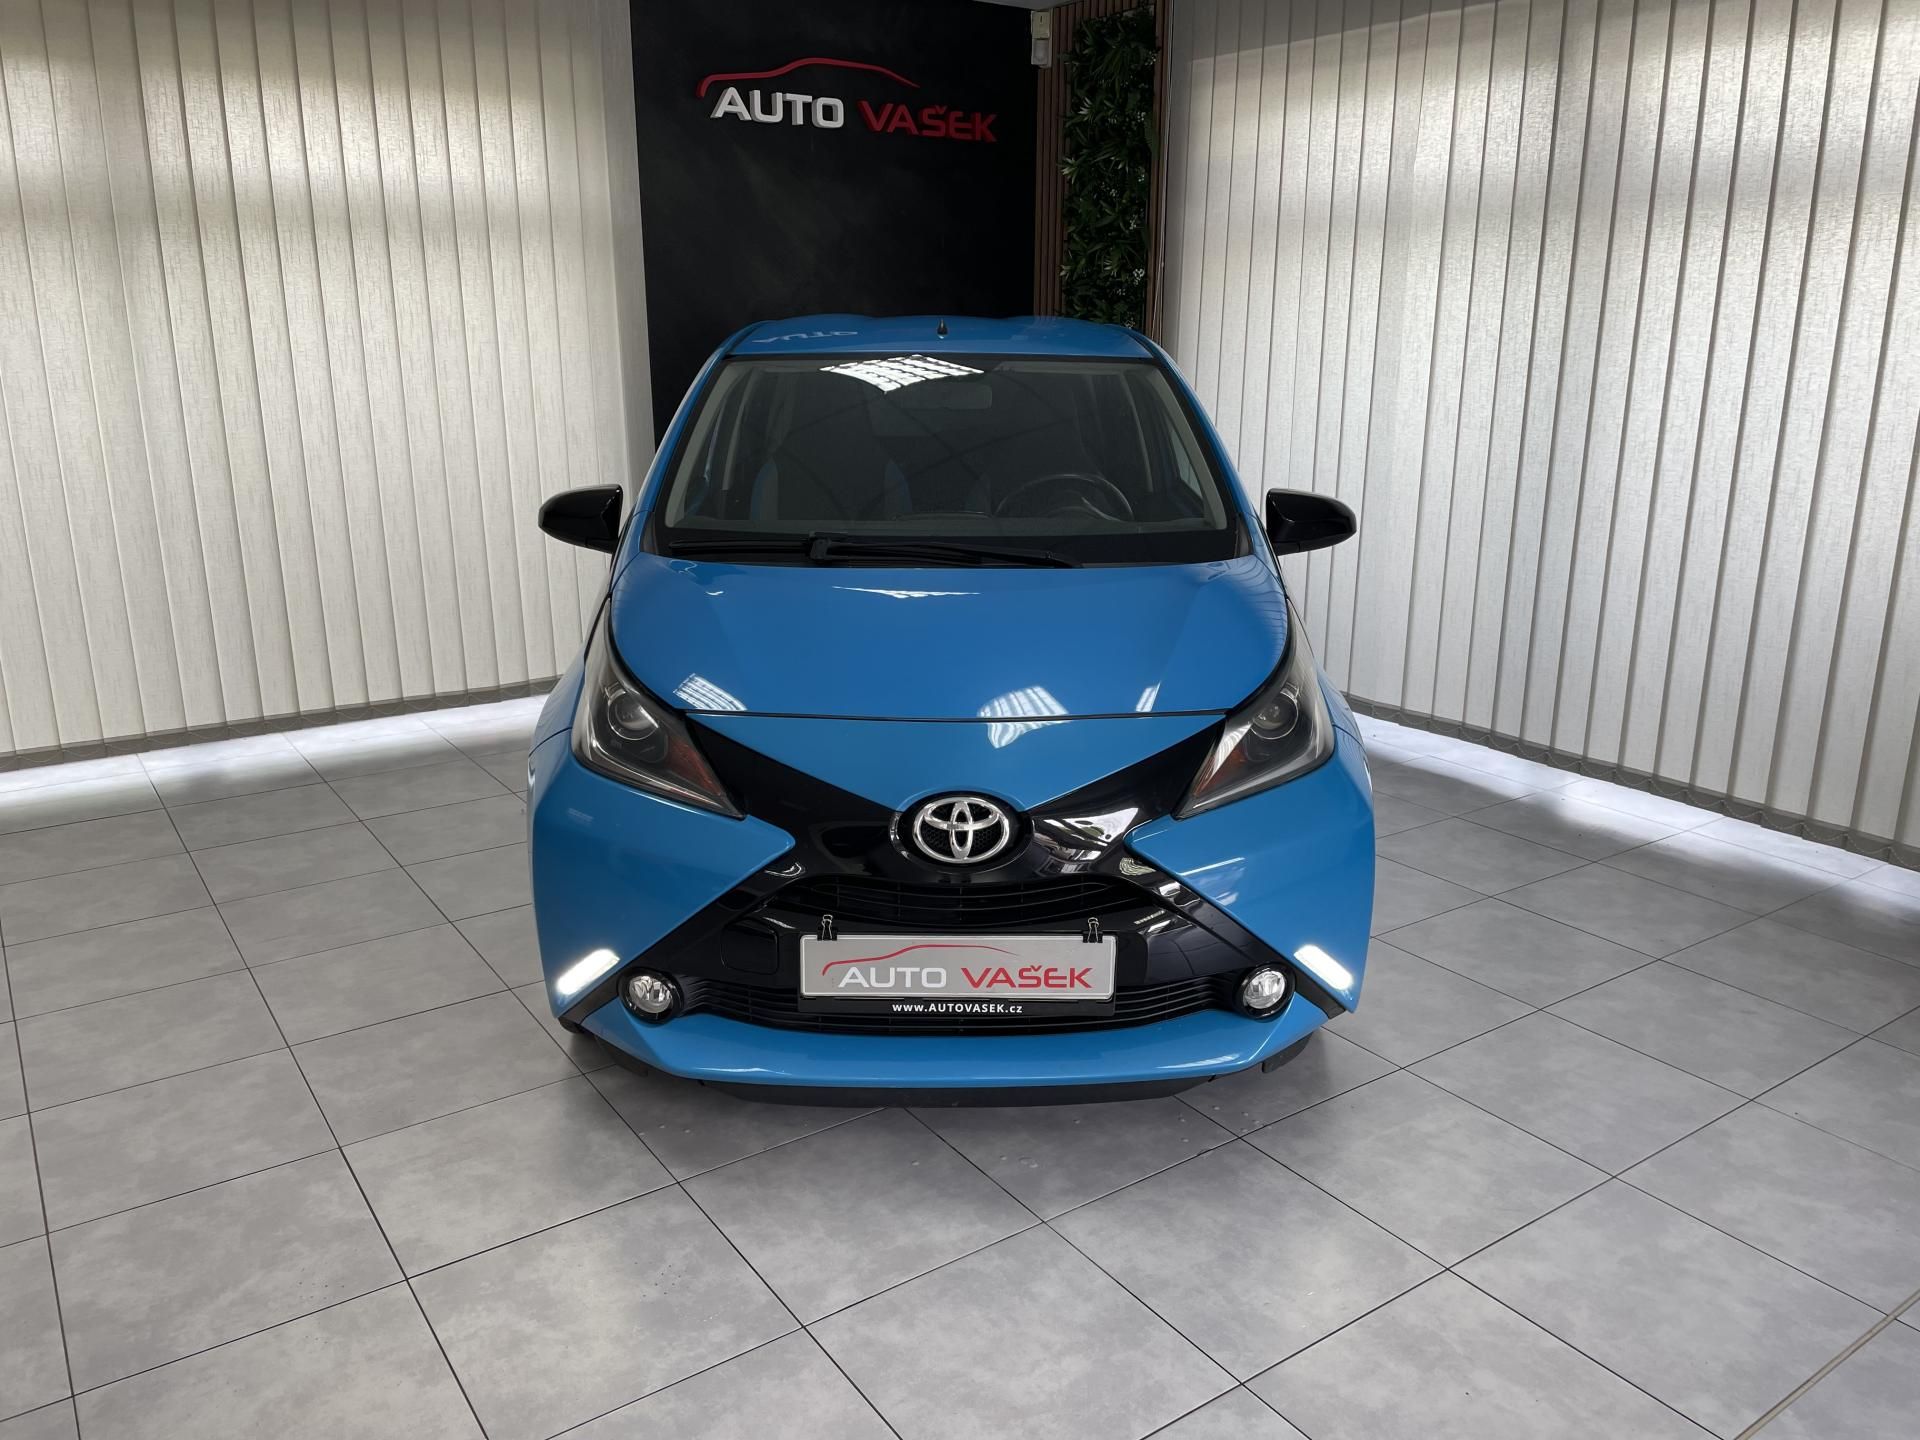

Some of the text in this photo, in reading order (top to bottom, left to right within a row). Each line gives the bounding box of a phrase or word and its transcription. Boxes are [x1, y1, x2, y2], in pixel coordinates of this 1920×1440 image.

[709, 86, 997, 142] AUTO VAŠEK
[838, 965, 1093, 989] AUTO VAŠEK
[891, 1002, 1024, 1014] www.AUTOVASEK.cz
